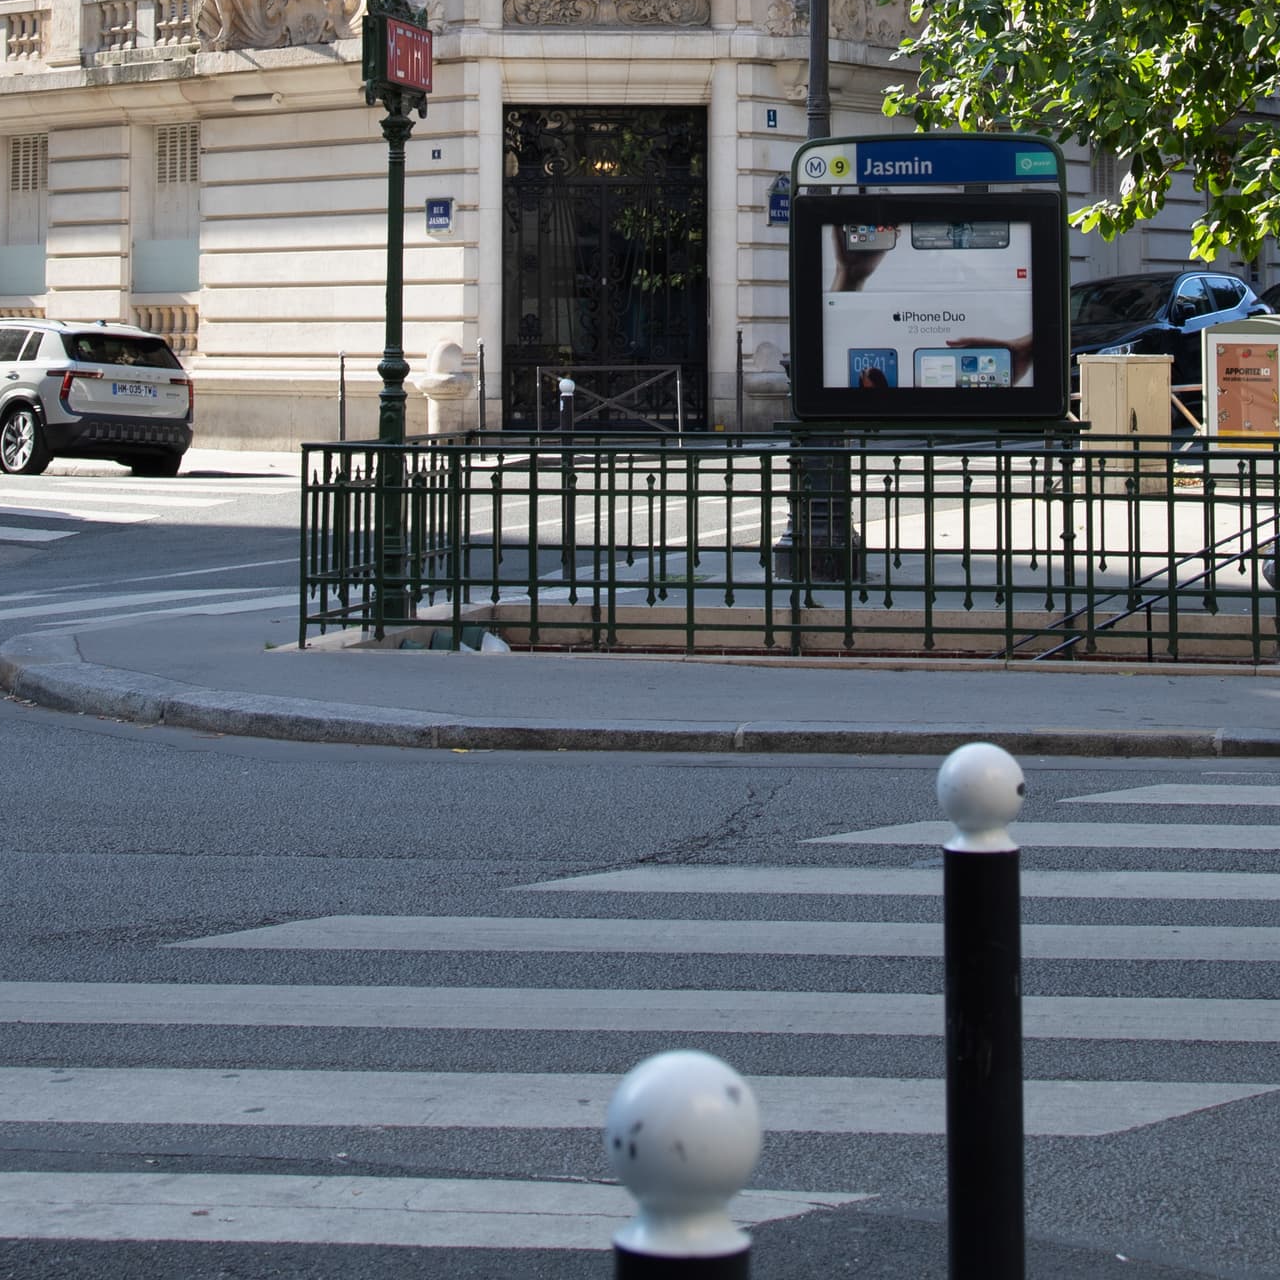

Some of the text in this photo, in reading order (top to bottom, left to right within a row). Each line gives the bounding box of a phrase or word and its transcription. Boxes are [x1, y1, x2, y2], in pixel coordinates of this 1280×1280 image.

[834, 160, 845, 174] 9
[863, 156, 933, 176] Jasmin
[428, 216, 449, 225] JASMIN
[902, 311, 966, 322] iPhone Duo
[920, 325, 951, 334] octobre
